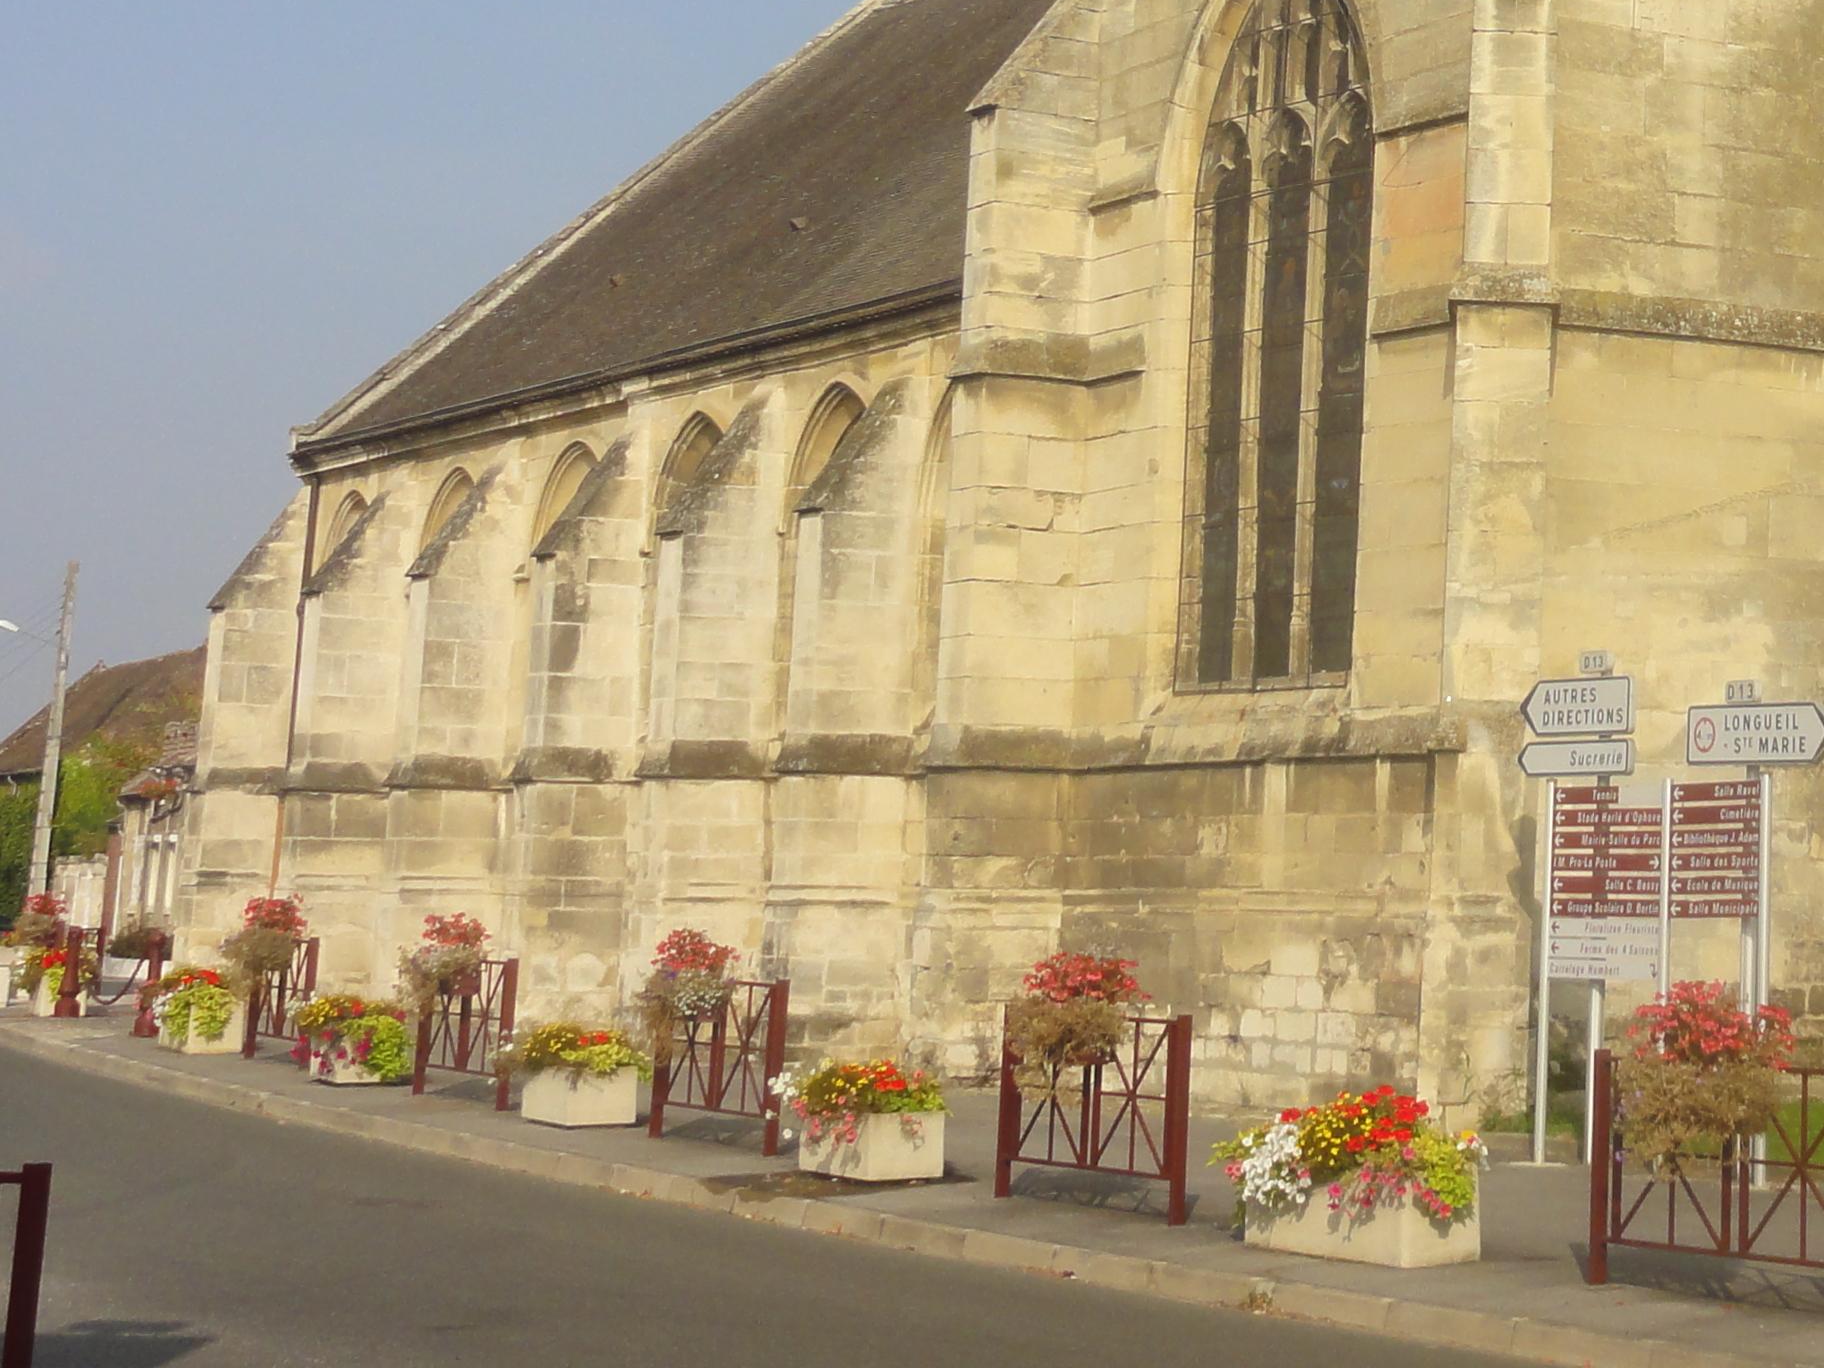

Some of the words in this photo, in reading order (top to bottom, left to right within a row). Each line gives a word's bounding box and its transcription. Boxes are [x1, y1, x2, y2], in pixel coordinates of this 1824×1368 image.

[1544, 687, 1597, 705] AUTRES
[1542, 708, 1624, 726] DIRECTIONS
[1724, 713, 1799, 731] LONGUEIL
[1758, 736, 1806, 753] MARIE
[1569, 749, 1623, 767] Sucrerie
[1592, 789, 1617, 801] Tennis
[1714, 785, 1734, 797] Salle
[1631, 834, 1640, 845] du
[1643, 833, 1660, 845] Parc
[1595, 856, 1617, 868] Poste
[1690, 855, 1711, 867] Salle
[1713, 856, 1728, 867] des
[1731, 854, 1758, 868] Sports
[1605, 879, 1624, 891] Salle
[1711, 879, 1721, 891] de
[1724, 878, 1758, 892] Musique
[1567, 901, 1592, 914] Groupe
[1594, 901, 1624, 913] Scolaire
[1689, 902, 1709, 914] Salle
[1712, 902, 1758, 915] Municipale
